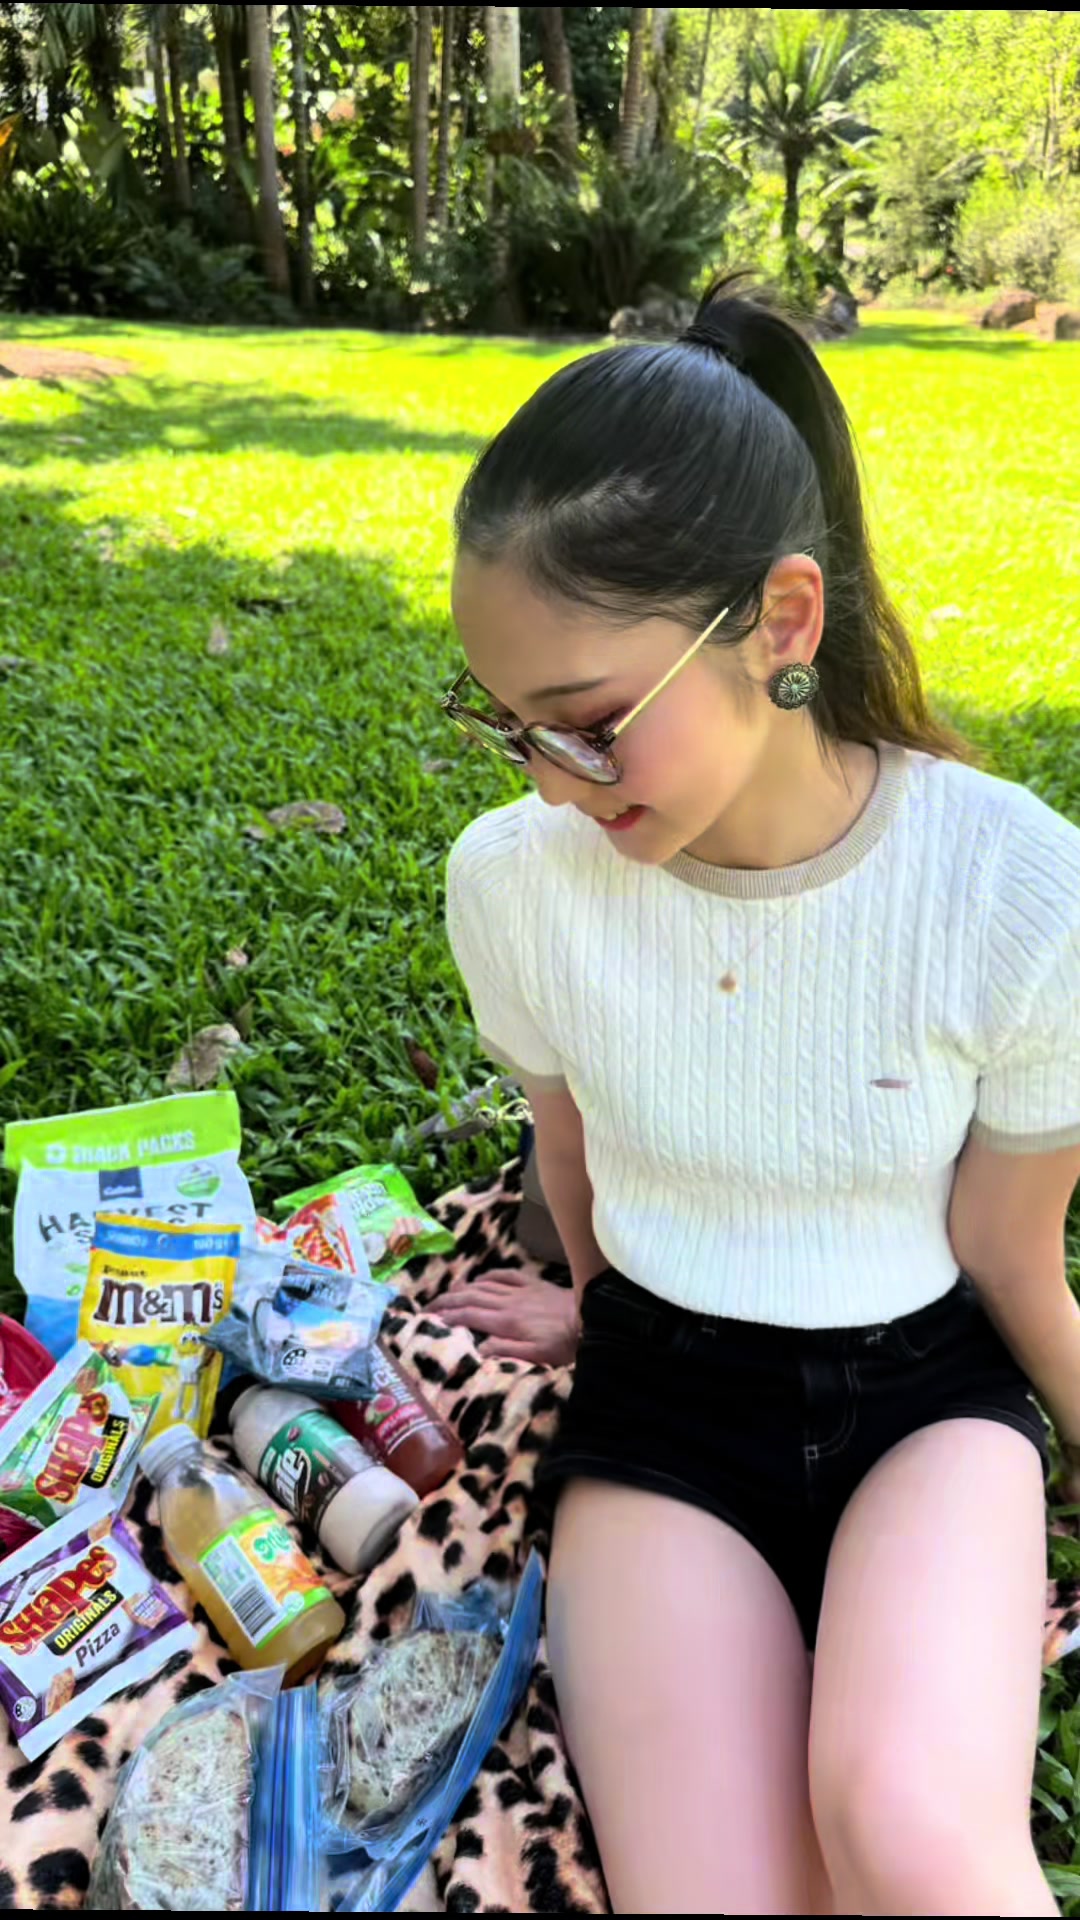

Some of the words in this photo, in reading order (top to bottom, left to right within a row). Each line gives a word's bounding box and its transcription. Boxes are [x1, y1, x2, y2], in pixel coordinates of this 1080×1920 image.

[91, 1419, 128, 1482] ORIGINALS
[54, 1590, 117, 1649] ORIGINALS
[75, 1621, 120, 1667] Pizza
